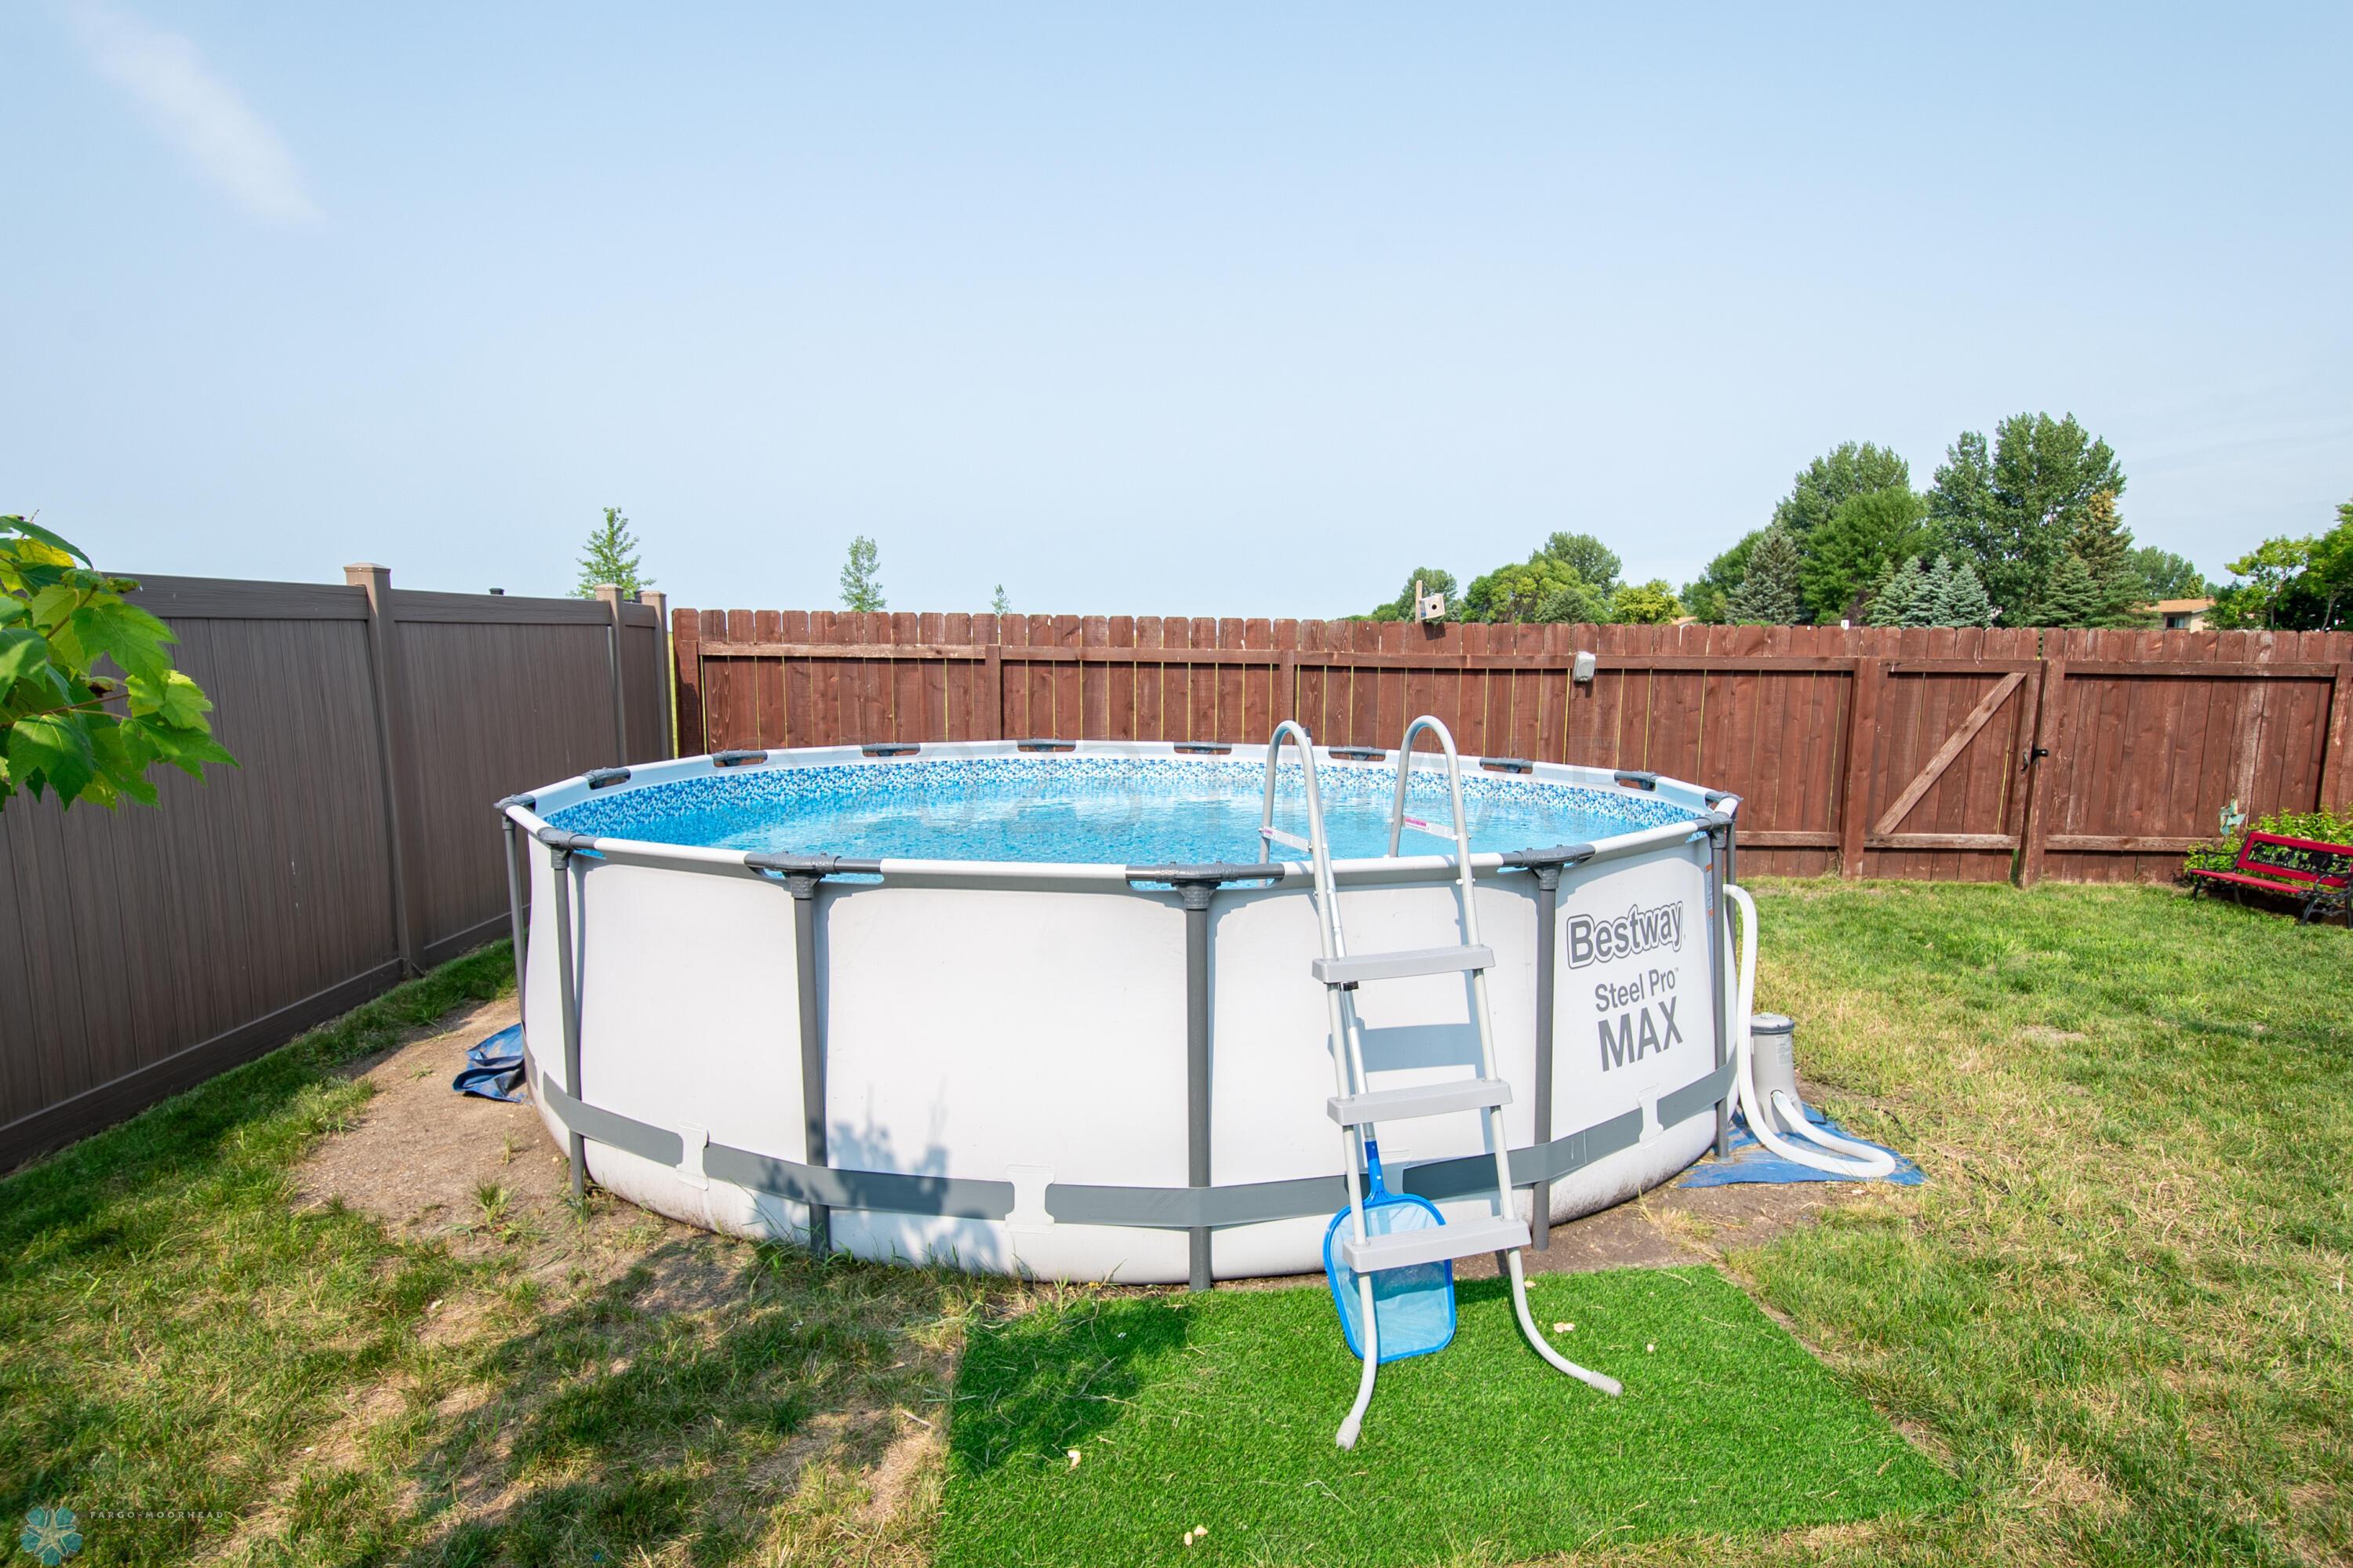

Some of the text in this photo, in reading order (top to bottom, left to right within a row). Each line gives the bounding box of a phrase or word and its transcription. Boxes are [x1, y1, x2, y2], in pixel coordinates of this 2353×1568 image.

[1568, 901, 1682, 969] Bestway
[1595, 973, 1645, 1011] Steel
[1598, 996, 1683, 1072] MAX
